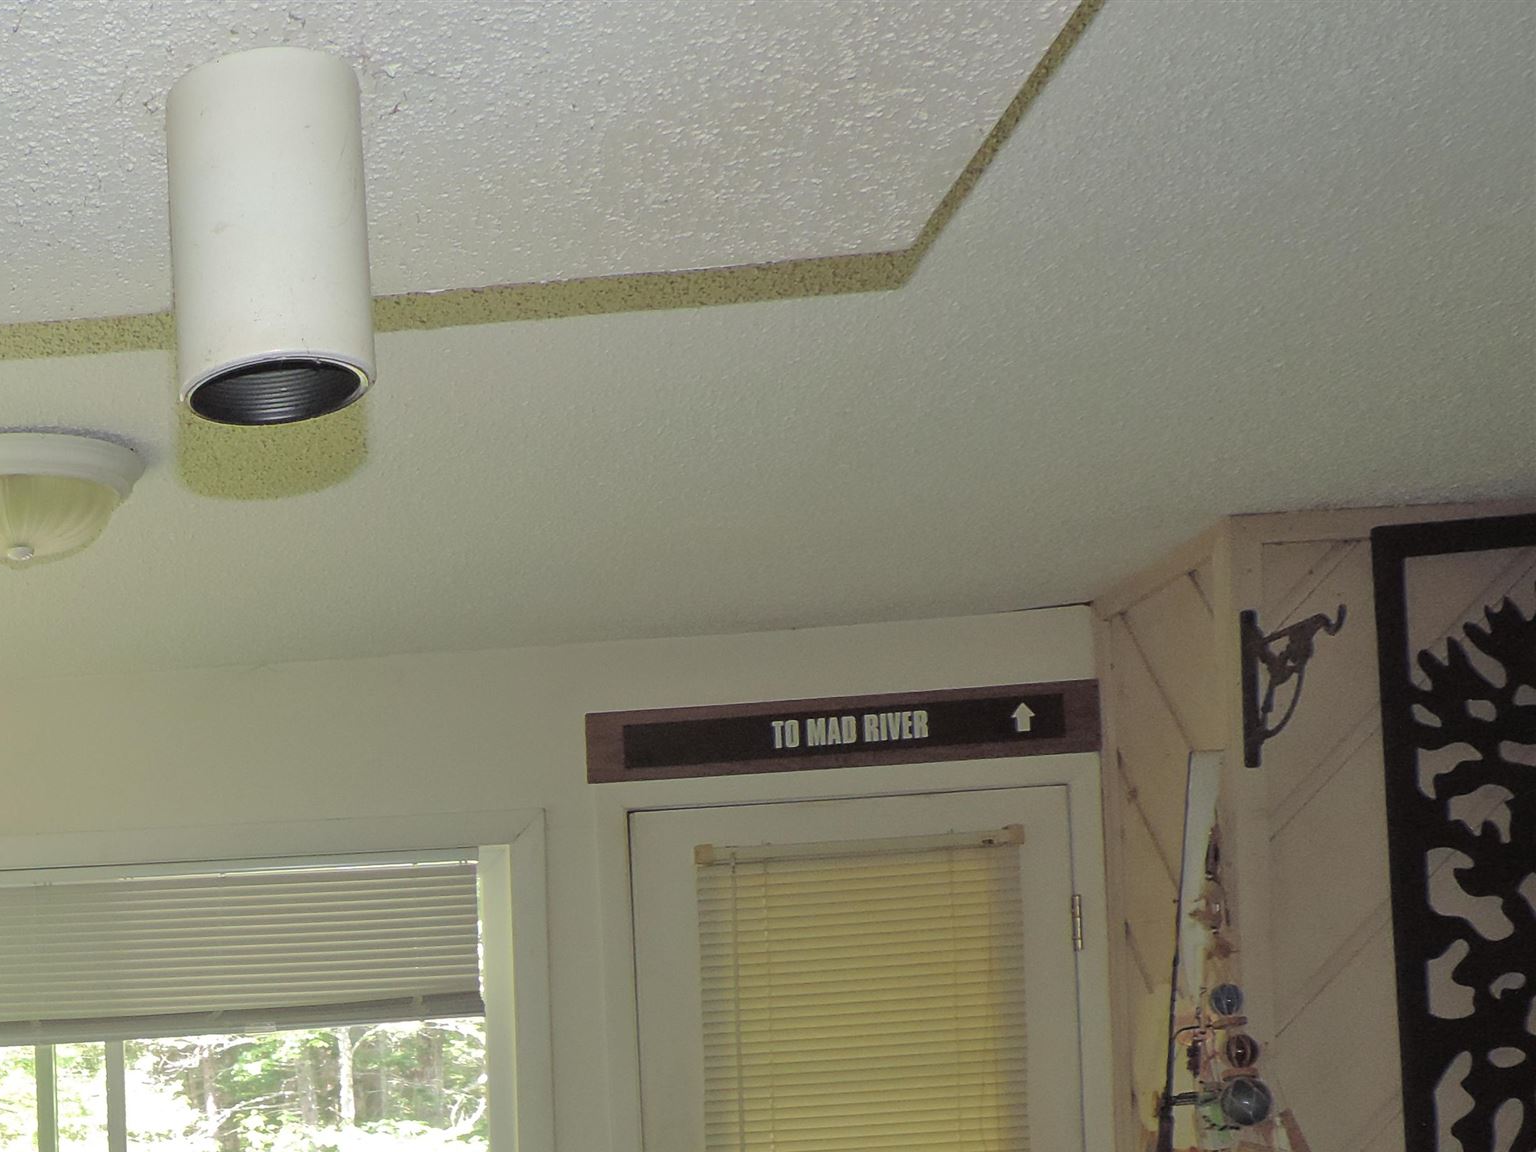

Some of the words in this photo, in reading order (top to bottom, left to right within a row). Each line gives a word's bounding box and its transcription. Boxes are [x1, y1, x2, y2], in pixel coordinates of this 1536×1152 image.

[771, 719, 800, 749] TO
[807, 715, 857, 747] MAD
[863, 710, 929, 742] RIVER
